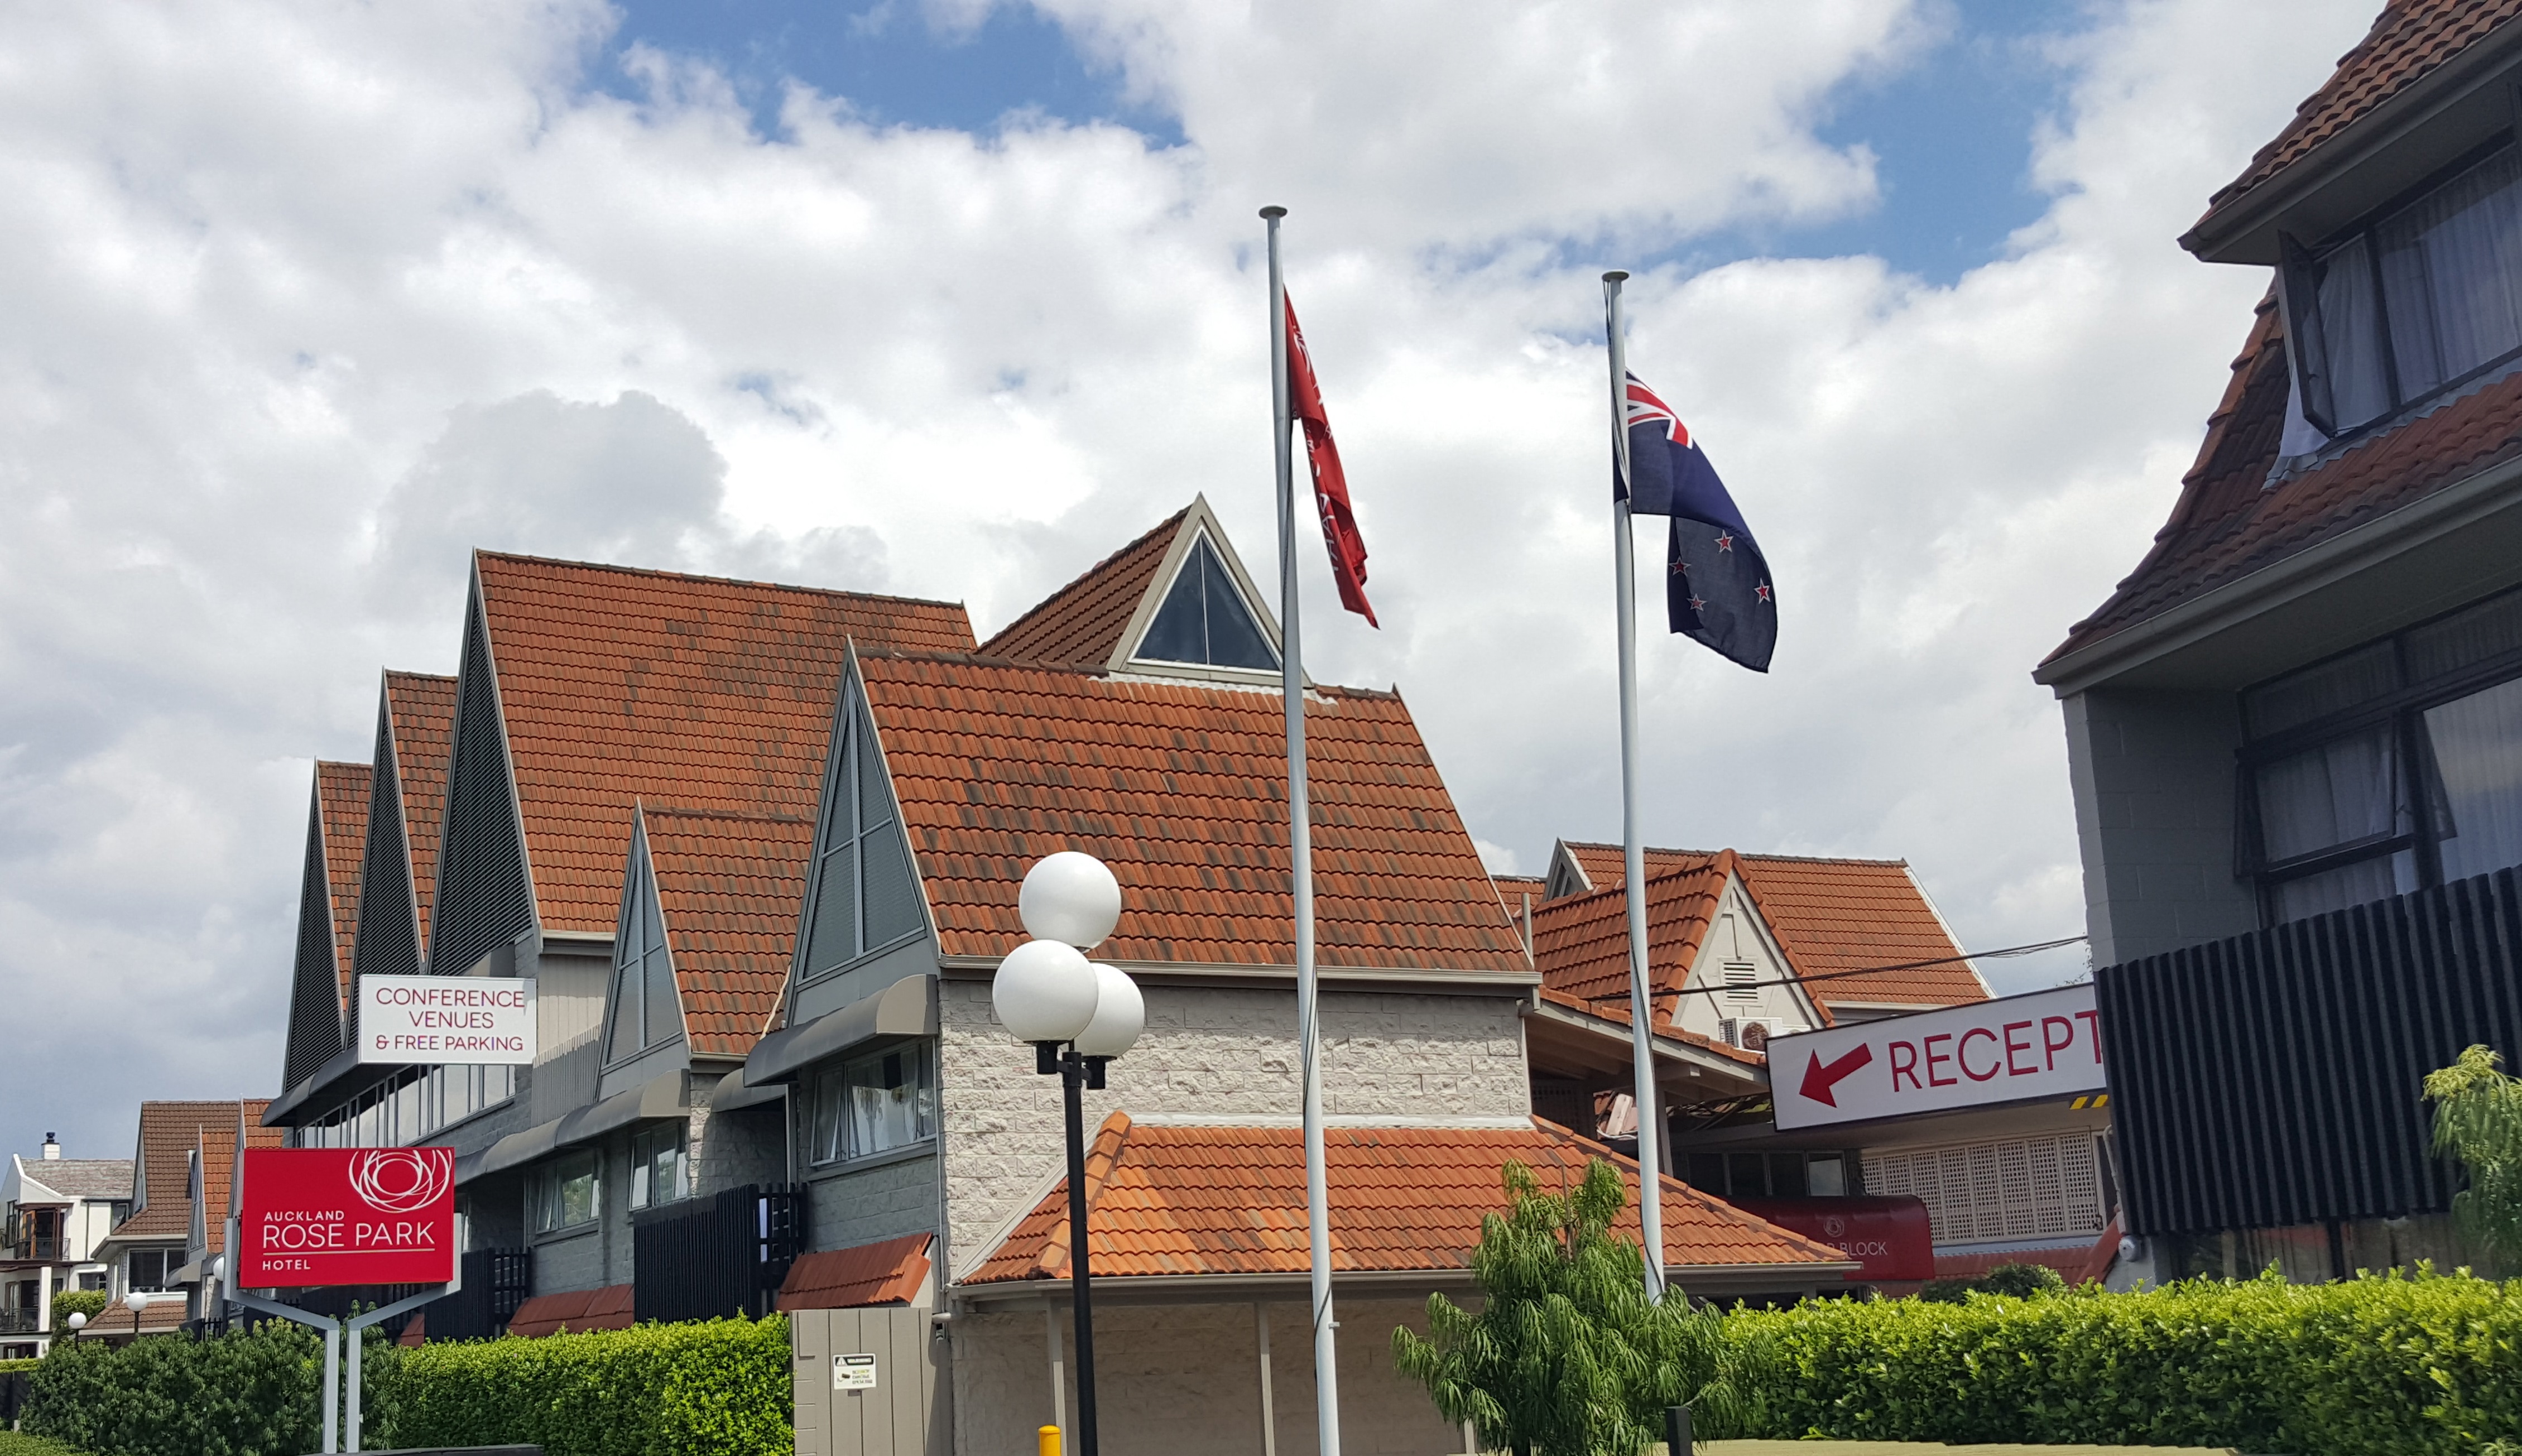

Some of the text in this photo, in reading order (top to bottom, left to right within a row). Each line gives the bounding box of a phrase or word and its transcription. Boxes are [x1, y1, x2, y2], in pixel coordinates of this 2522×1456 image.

[376, 987, 525, 1007] CONFERENCE
[409, 1011, 494, 1029] VENUES
[376, 1035, 523, 1051] & FREE PARKING
[263, 1210, 345, 1222] AUCKLAND
[263, 1221, 435, 1248] ROSE PARK
[1839, 1242, 1888, 1256] BLOCK
[262, 1259, 311, 1271] HOTEL
